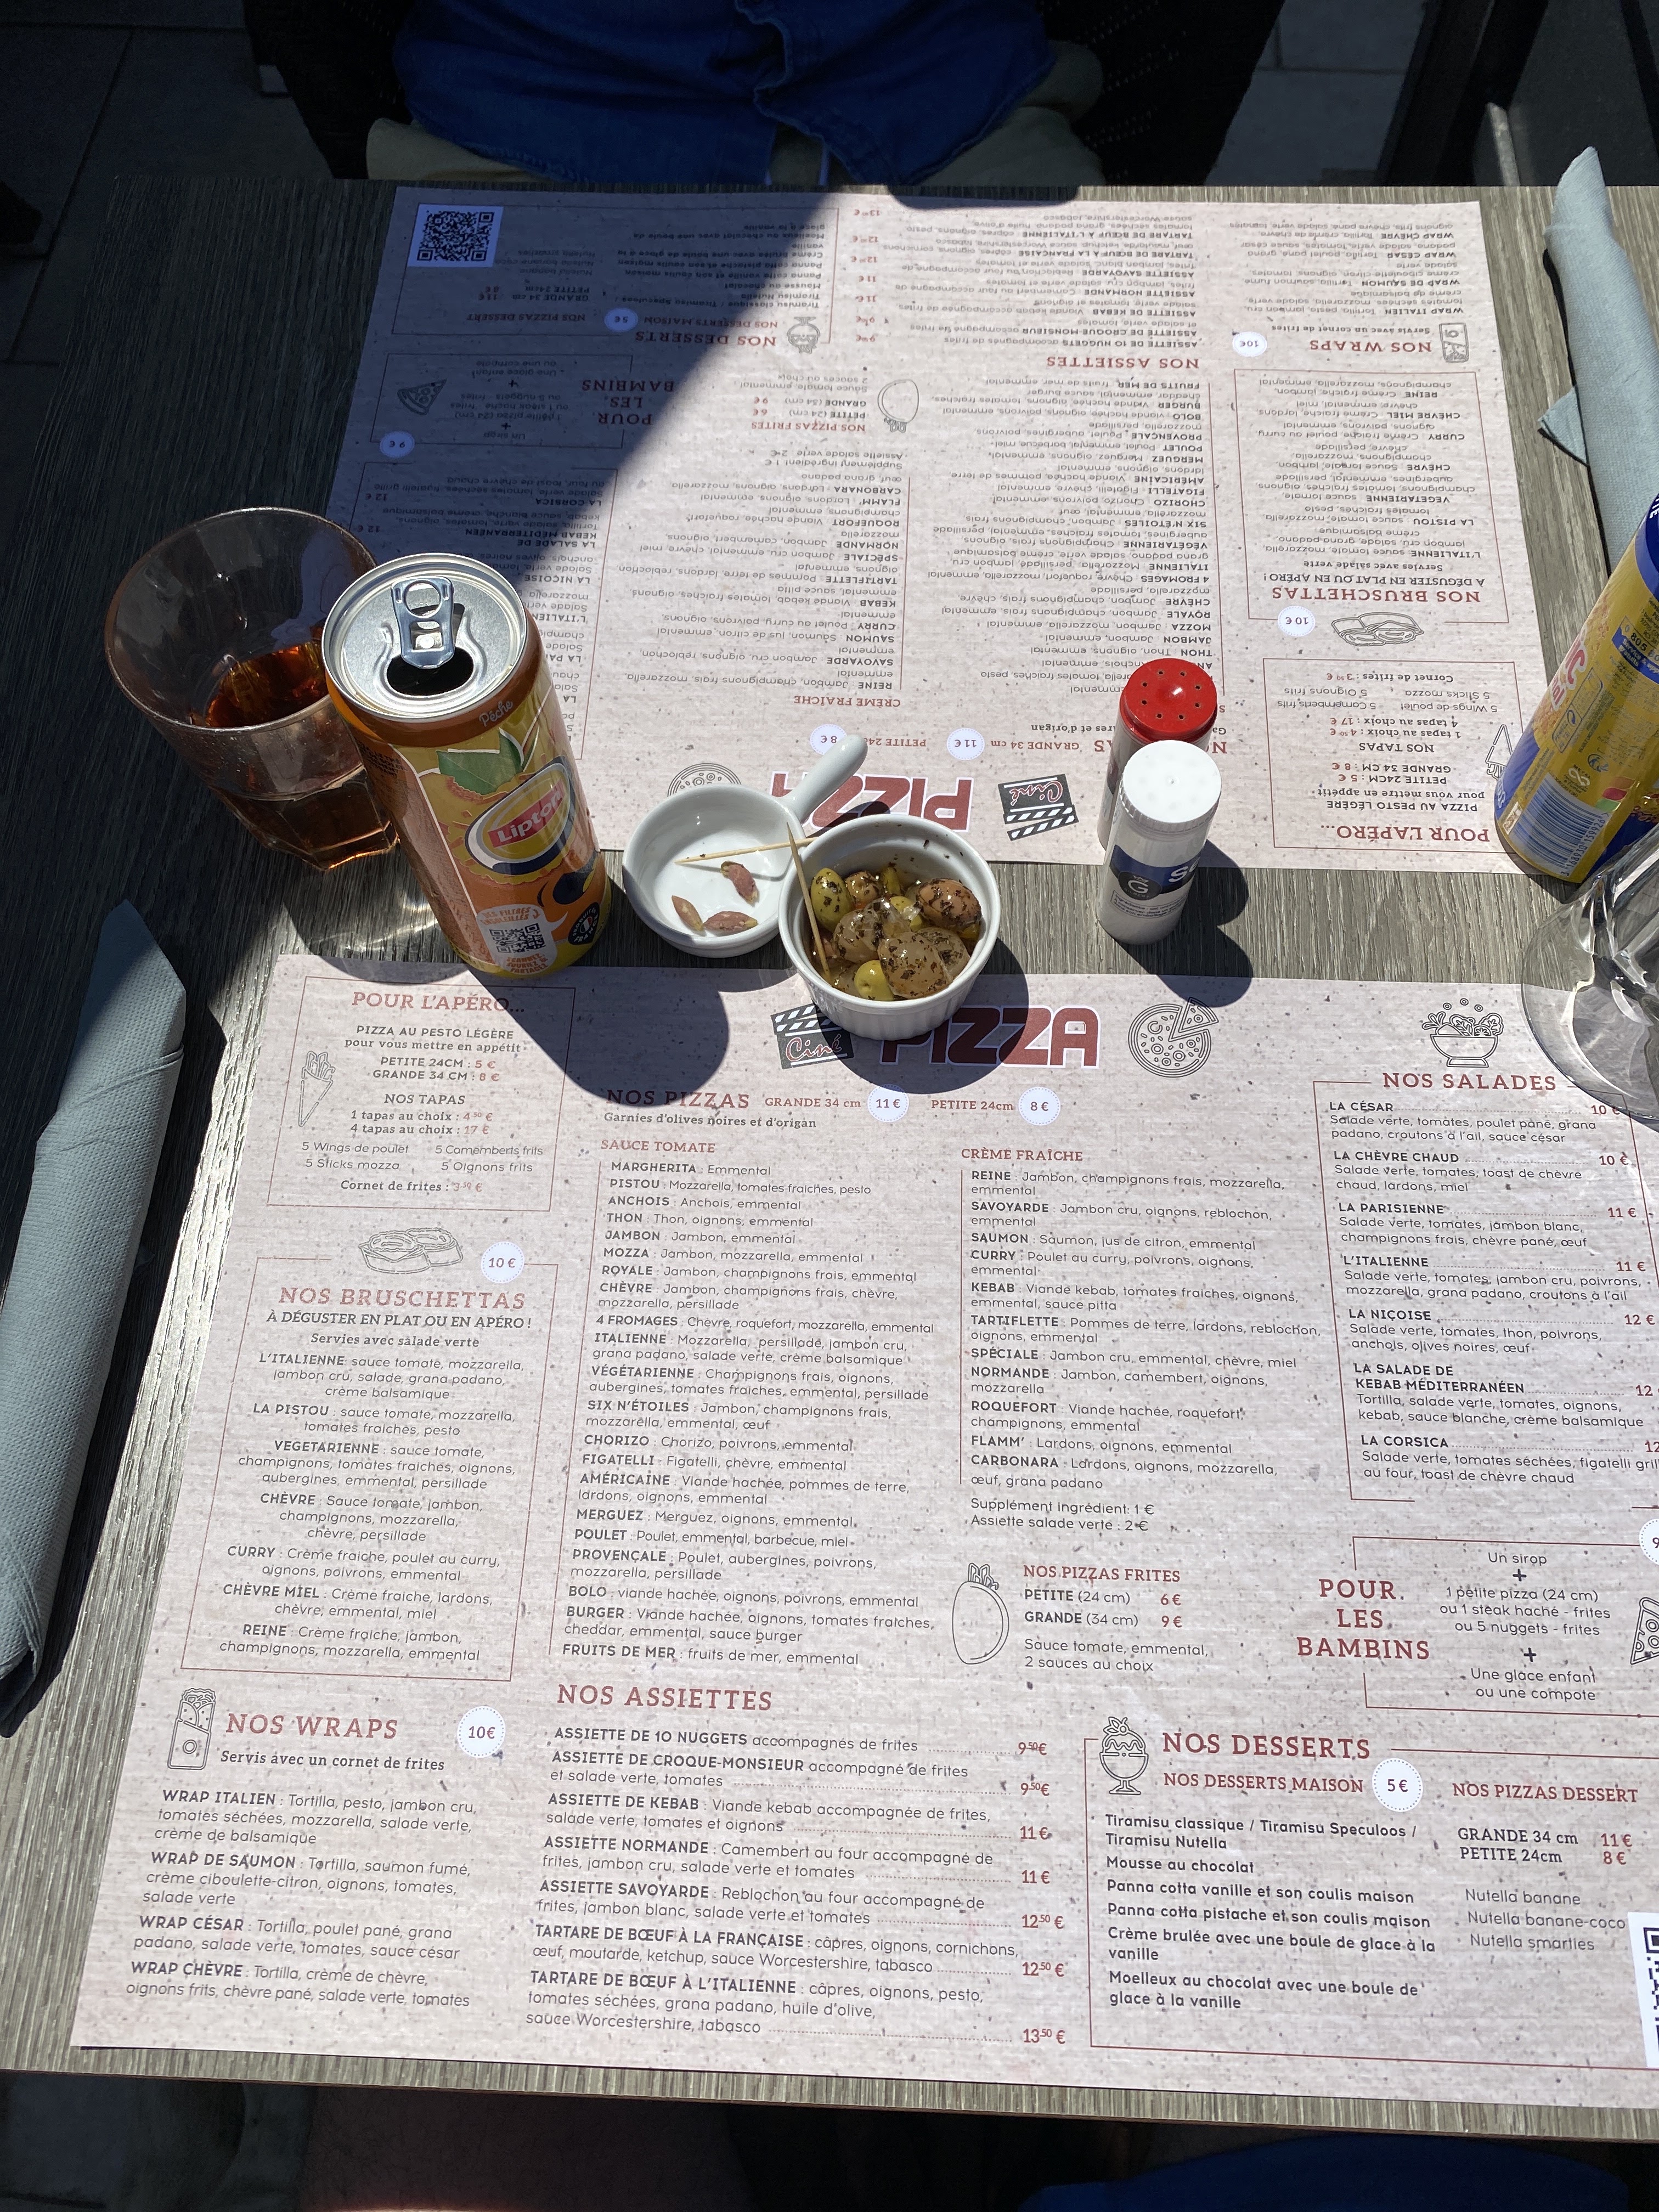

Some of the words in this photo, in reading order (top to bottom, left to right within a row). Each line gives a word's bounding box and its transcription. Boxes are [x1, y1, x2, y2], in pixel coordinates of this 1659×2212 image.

[636, 331, 729, 347] DESSERTS
[737, 336, 776, 347] NOS
[1310, 340, 1383, 352] WRAPS
[1391, 342, 1431, 352] NOS
[1047, 357, 1150, 368] ASSIETTES
[1160, 359, 1199, 368] NOS
[582, 380, 675, 392] BAMBINS
[610, 397, 643, 408] LES
[599, 413, 653, 425] POUR
[752, 421, 791, 430] FRITES
[796, 420, 837, 431] PIZZAS
[1273, 588, 1428, 602] BRUSCHETTAS
[1437, 591, 1480, 602] NOS
[794, 696, 852, 706] FRAÎCHE
[856, 698, 900, 708] CRÈME
[479, 699, 514, 727] Pêche
[1359, 743, 1403, 752] TAPAS
[1407, 743, 1434, 752] NOS
[1009, 781, 1063, 806] Ciné
[498, 789, 561, 843] Lipton
[1429, 826, 1489, 842] POUR
[352, 992, 414, 1010] POUR
[357, 1025, 394, 1035] PIZZA
[399, 1028, 416, 1036] AU
[421, 1028, 461, 1037] PESTO
[467, 1028, 514, 1039] LÉGÈRE
[786, 1034, 843, 1063] Ciné
[1383, 1073, 1432, 1087] NOS
[1443, 1074, 1555, 1090] SALADES
[607, 1089, 655, 1105] NOS
[664, 1089, 749, 1109] PIZZAS
[765, 1098, 821, 1107] GRANDE
[825, 1098, 839, 1107] 34
[1330, 1102, 1345, 1110] LA
[1351, 1101, 1393, 1113] CÉSAR
[605, 1113, 652, 1122] Garnies
[657, 1114, 703, 1124] d'olives
[708, 1116, 746, 1127] noires
[751, 1117, 761, 1126] et
[766, 1118, 816, 1130] d'origan
[601, 1139, 649, 1150] SAUCE
[654, 1142, 715, 1153] TOMATE
[962, 1147, 1011, 1159] CRÈME
[1016, 1149, 1082, 1161] FRAÎCHE
[1334, 1151, 1350, 1160] LA
[1356, 1150, 1408, 1161] CHÈVRE
[1413, 1153, 1459, 1162] CHAUD
[1335, 1165, 1379, 1174] Salade
[1383, 1164, 1418, 1176] verte,
[1423, 1167, 1478, 1178] tomates,
[1483, 1169, 1514, 1178] toast
[1519, 1169, 1534, 1177] de
[1539, 1170, 1582, 1178] chèvre
[1339, 1203, 1355, 1212] LA
[1361, 1203, 1444, 1214] PARISIENNE
[1608, 1207, 1623, 1217] 11
[1628, 1208, 1637, 1217] €
[1344, 1256, 1429, 1267] L'ITALIENNE
[279, 1288, 330, 1304] NOS
[340, 1289, 524, 1309] BRUSCHETTAS
[266, 1310, 277, 1322] À
[281, 1310, 356, 1324] DÉGUSTER
[360, 1314, 381, 1325] EN
[384, 1315, 421, 1325] PLAT
[422, 1316, 447, 1327] OU
[450, 1317, 471, 1327] EN
[1349, 1309, 1365, 1318] LA
[1371, 1310, 1431, 1321] NIÇOISE
[1624, 1314, 1641, 1325] 12
[1646, 1315, 1655, 1325] €
[1353, 1363, 1372, 1373] LA
[1377, 1364, 1430, 1375] SALADE
[1436, 1366, 1453, 1375] DE
[1356, 1379, 1401, 1389] KEBAB
[1405, 1378, 1525, 1393] MÉDITERRANÉEN
[1361, 1435, 1378, 1445] LA
[1384, 1436, 1448, 1448] CORSICA
[1488, 1553, 1507, 1563] Un
[1513, 1554, 1547, 1566] sirop
[1024, 1565, 1056, 1577] NOS
[1062, 1566, 1119, 1581] PIZZAS
[1125, 1569, 1180, 1582] FRITES
[1319, 1579, 1396, 1599] POUR
[1025, 1611, 1082, 1623] GRANDE
[1087, 1613, 1108, 1626] (34
[1113, 1615, 1138, 1627] cm)
[1337, 1609, 1383, 1628] LES
[1297, 1637, 1429, 1660] BAMBINS
[557, 1684, 613, 1705] NOS
[624, 1687, 771, 1711] ASSIETTES
[226, 1713, 284, 1734] NOS
[296, 1716, 397, 1739] WRAPS
[555, 1728, 625, 1740] ASSIETTE
[631, 1730, 650, 1741] DE
[655, 1731, 672, 1742] 10
[678, 1731, 747, 1747] NUGGETS
[1163, 1733, 1220, 1753] NOS
[1232, 1735, 1369, 1760] DESSERTS
[552, 1751, 623, 1764] ASSIETTE
[629, 1754, 647, 1765] DE
[653, 1754, 803, 1771] CROQUE-MONSIEUR
[1164, 1773, 1198, 1786] NOS
[1204, 1774, 1286, 1790] DESSERTS
[1292, 1778, 1363, 1792] MAISON
[1452, 1783, 1489, 1797] NOS
[1494, 1785, 1557, 1799] PIZZAS
[1562, 1787, 1638, 1802] DESSERT
[159, 1809, 218, 1821] tomates
[224, 1812, 285, 1825] séchées,
[291, 1815, 374, 1829] mozzarella,
[381, 1817, 427, 1829] salade
[433, 1820, 471, 1833] verte,
[1105, 1833, 1170, 1847] Tiramisu
[1176, 1836, 1226, 1849] Nutella
[1458, 1828, 1528, 1842] GRANDE
[1533, 1831, 1551, 1843] 34
[1557, 1835, 1578, 1844] cm
[1460, 1847, 1516, 1860] PETITE
[1522, 1849, 1562, 1863] 24cm
[1107, 1856, 1161, 1869] Mousse
[1168, 1861, 1185, 1870] au
[1192, 1859, 1254, 1873] chocolat
[1466, 1889, 1517, 1902] Nutella
[1523, 1891, 1580, 1905] banane
[526, 2013, 570, 2025] sauce
[577, 2013, 694, 2032] Worcestershire,
[701, 2019, 760, 2033] tabasco
